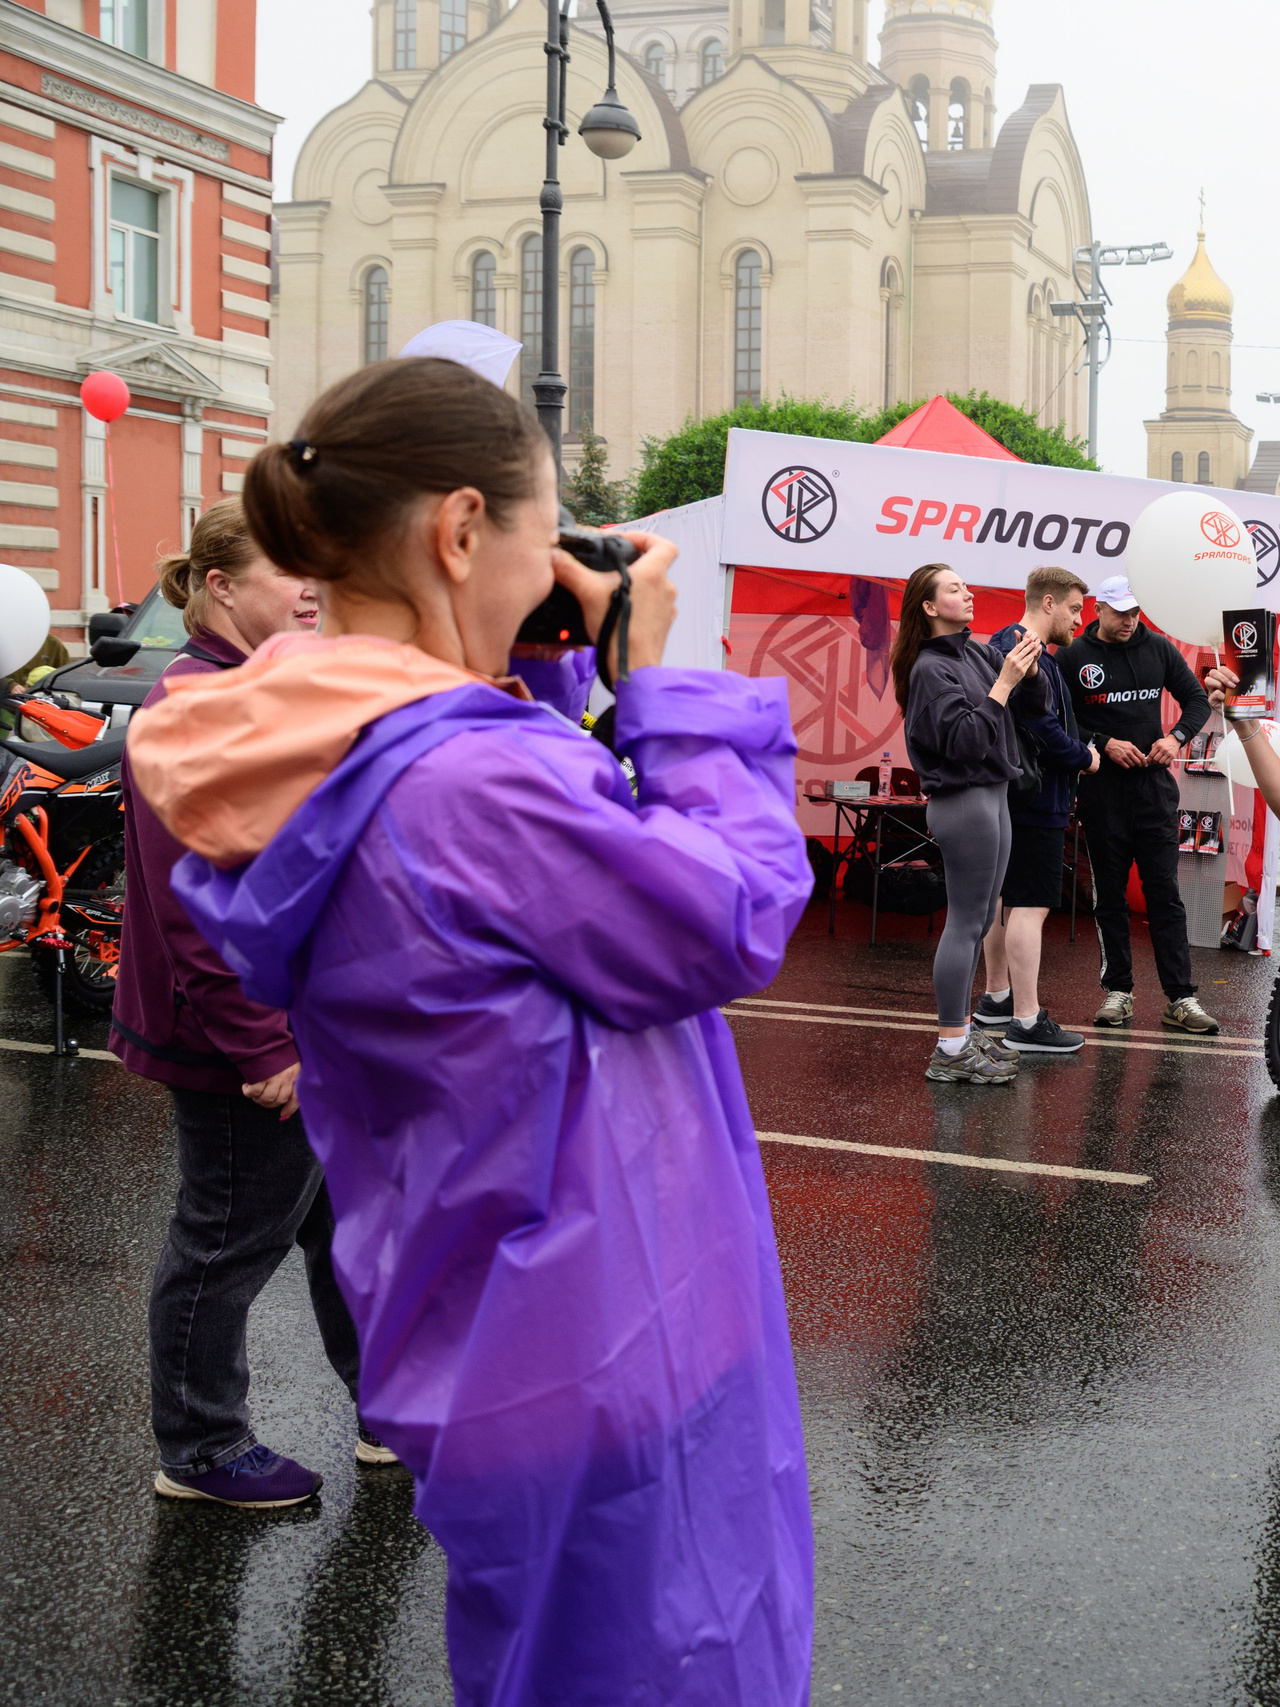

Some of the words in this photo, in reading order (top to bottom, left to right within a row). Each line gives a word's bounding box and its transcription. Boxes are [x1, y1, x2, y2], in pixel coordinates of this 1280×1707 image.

[1193, 550, 1252, 565] SPRMOTORS
[1083, 687, 1161, 706] SPRMOTORS
[84, 771, 110, 794] MAX
[85, 908, 102, 916] SPR
